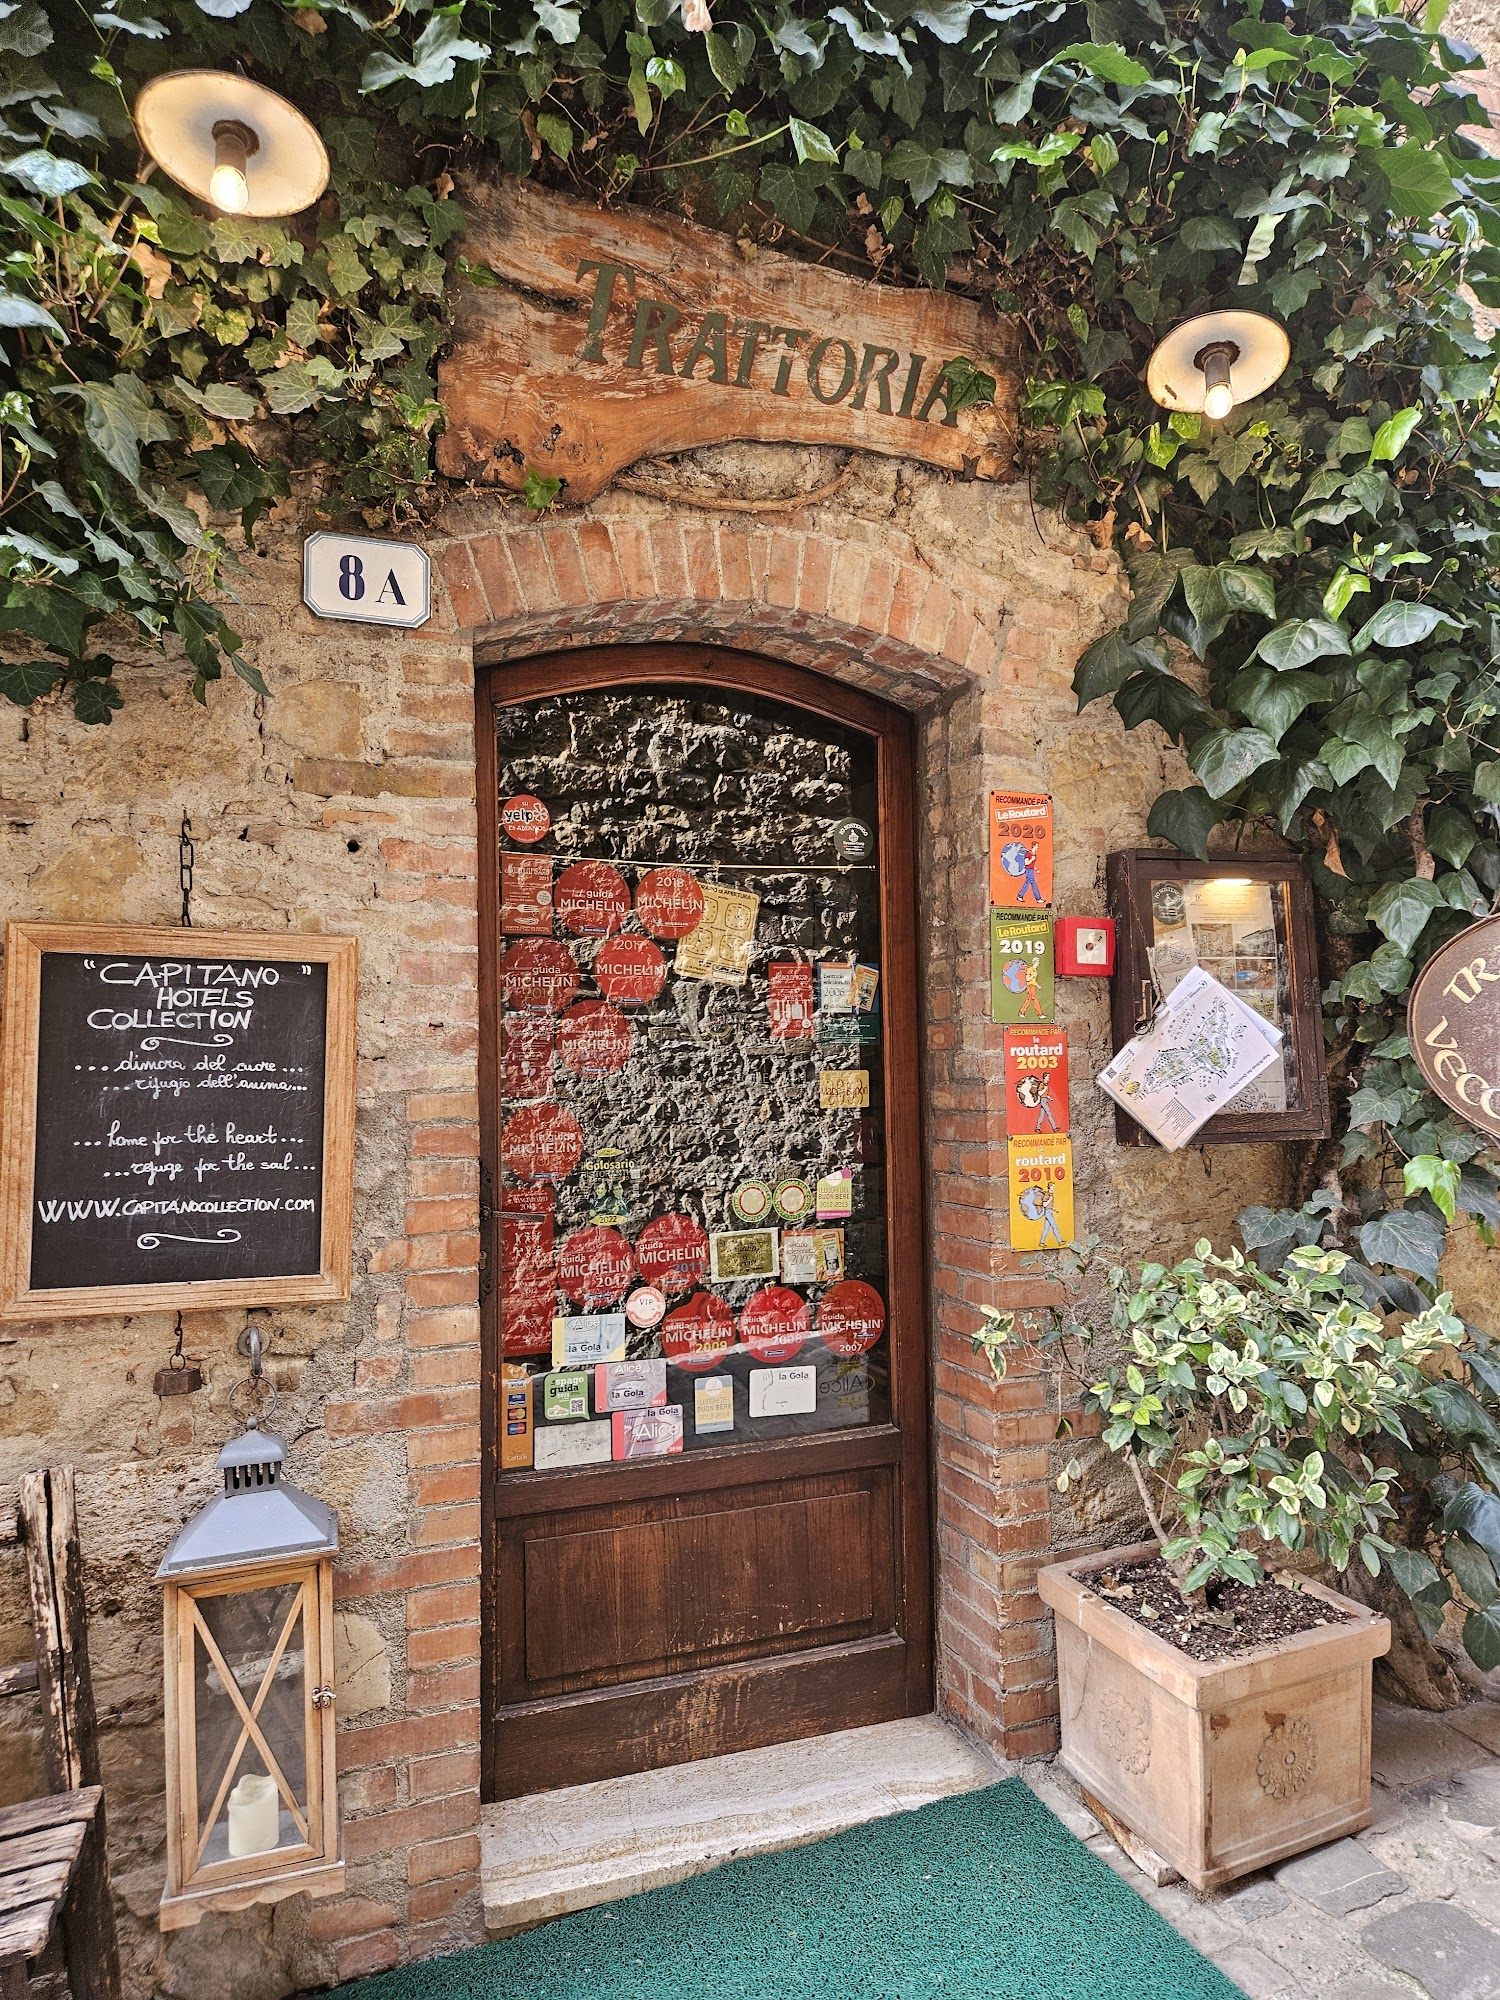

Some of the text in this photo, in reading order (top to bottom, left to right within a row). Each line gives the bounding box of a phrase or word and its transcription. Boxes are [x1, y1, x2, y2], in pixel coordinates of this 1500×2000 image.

[576, 258, 959, 428] TRATTORIA
[338, 554, 410, 607] 8 A
[995, 795, 1036, 806] RECOMMANDÉ
[503, 808, 534, 825] yelp
[998, 822, 1046, 839] 2020
[586, 889, 614, 900] guida
[560, 898, 626, 912] MICHELIN
[636, 896, 704, 911] MICHELIN
[995, 912, 1049, 922] RECOMMANDÉ PAR
[999, 940, 1046, 955] 2019
[532, 966, 561, 975] guida
[596, 963, 664, 976] MICHELIN
[1442, 945, 1500, 1003] TR
[505, 976, 573, 987] MICHELIN
[156, 987, 255, 1010] HOTELS
[823, 987, 845, 997] 2006
[86, 1009, 253, 1031] COLLECTION
[587, 1029, 616, 1038] guida
[1050, 1027, 1063, 1036] PAR
[562, 1039, 627, 1051] MICHELIN
[1033, 1036, 1040, 1044] le
[1010, 1044, 1063, 1057] routard
[192, 1054, 226, 1073] del
[1016, 1056, 1059, 1070] 2003
[152, 1131, 182, 1156] for
[184, 1122, 219, 1145] the
[1013, 1136, 1067, 1148] RECOMMANDÉ PAR
[509, 1142, 577, 1155] MICHELIN
[585, 1158, 635, 1171] Golosario
[1015, 1153, 1066, 1167] routard
[193, 1157, 220, 1183] for
[221, 1151, 256, 1171] the
[1018, 1166, 1066, 1182] 2010
[37, 1197, 316, 1225] WWW.CAPITANOCOLLECTION.COM
[599, 1215, 617, 1224] 2022
[639, 1242, 664, 1252] guida
[560, 1253, 586, 1266] guida
[639, 1246, 706, 1265] MICHELIN
[560, 1258, 631, 1279] MICHELIN
[673, 1262, 704, 1274] 2011
[595, 1274, 630, 1288] 2012
[639, 1298, 654, 1306] VIP
[574, 1317, 601, 1329] Alice
[742, 1315, 767, 1324] guida
[821, 1319, 881, 1332] MICHELIN
[665, 1322, 690, 1332] guida
[743, 1320, 807, 1335] MICHELIN
[665, 1327, 733, 1343] MICHELIN
[568, 1345, 578, 1353] la
[580, 1343, 601, 1352] Gola
[695, 1340, 728, 1354] 2009
[839, 1343, 863, 1352] 2007
[615, 1363, 642, 1374] Alice
[554, 1377, 584, 1387] spago
[789, 1371, 809, 1380] Gola
[550, 1384, 579, 1397] guida
[611, 1391, 620, 1399] la
[623, 1389, 644, 1398] Gola
[647, 1409, 656, 1417] la
[659, 1407, 679, 1416] Gola
[697, 1402, 732, 1412] BUON BERE
[699, 1412, 730, 1421] 2013-2014
[636, 1422, 680, 1440] Alice
